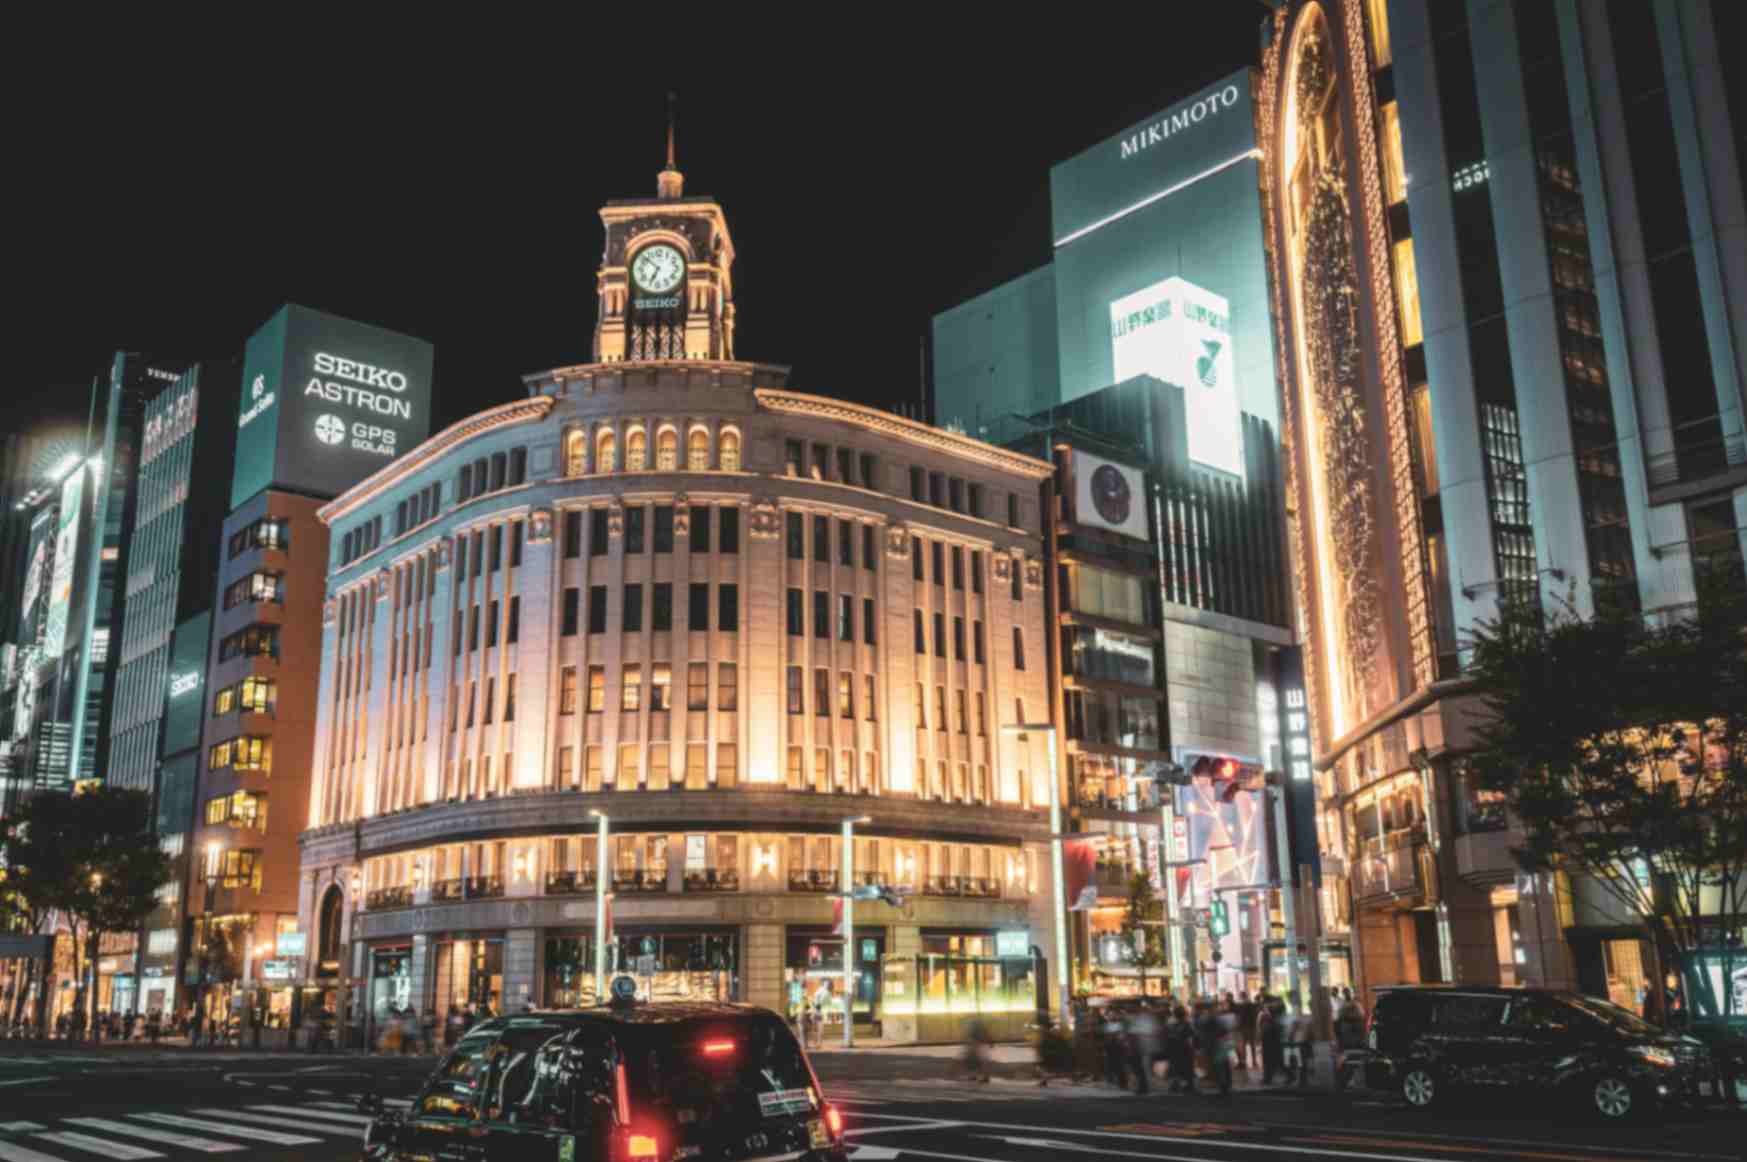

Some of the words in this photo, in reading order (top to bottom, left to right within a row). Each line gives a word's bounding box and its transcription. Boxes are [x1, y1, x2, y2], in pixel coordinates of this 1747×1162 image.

[1121, 85, 1238, 159] MIKIMOTO
[634, 297, 679, 308] SEIKO
[314, 352, 407, 391] SEIKO
[304, 378, 411, 419] ASTRON
[352, 422, 396, 445] GPS
[352, 438, 395, 456] SOLAR
